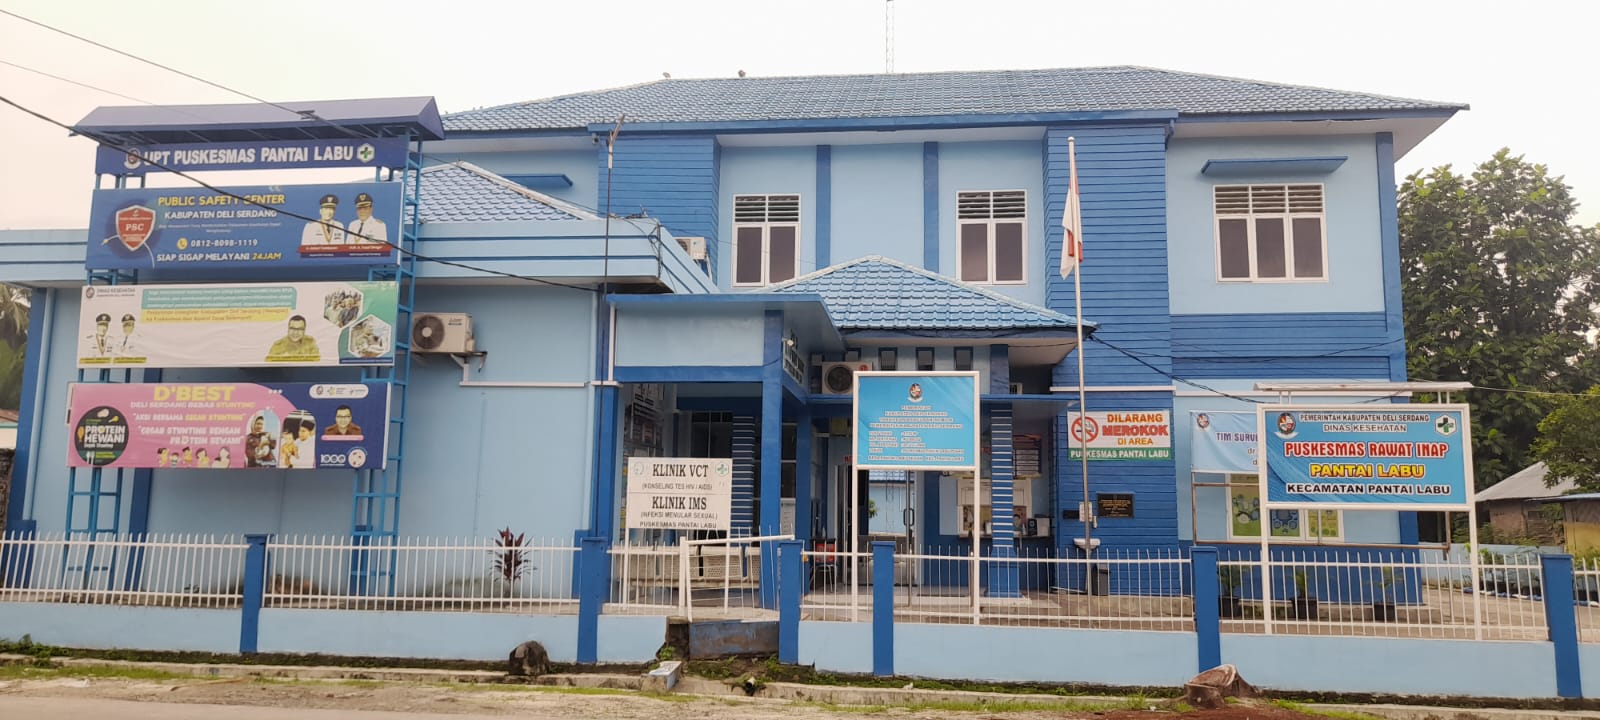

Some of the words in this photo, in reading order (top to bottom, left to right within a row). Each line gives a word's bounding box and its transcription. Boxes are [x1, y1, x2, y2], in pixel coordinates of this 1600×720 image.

[144, 151, 170, 166] UPT
[174, 149, 256, 165] PUSKESMAS
[260, 147, 308, 163] PANTAI
[313, 146, 354, 161] LABU
[158, 197, 195, 206] PUBLIC
[200, 195, 240, 206] SAFETY
[243, 195, 285, 205] CENTER
[164, 210, 214, 219] KABUPATEN
[191, 239, 258, 247] 0812-8098-1119
[205, 253, 250, 261] MELAYANI
[153, 386, 236, 401] D'BEST
[1107, 413, 1163, 423] DILARANG
[1300, 414, 1342, 422] PEMERINTAH
[1343, 414, 1381, 422] KABUPATEN
[85, 425, 126, 433] PROTEIN
[1102, 425, 1169, 437] MEROKOK
[1323, 424, 1351, 433] DINAS
[1353, 424, 1408, 433] KESEHATAN
[84, 433, 125, 443] HEWANI
[1216, 432, 1232, 441] TIM
[1117, 438, 1127, 446] DI
[1128, 438, 1154, 446] AREA
[1070, 450, 1117, 458] PUKESMAS
[1118, 450, 1147, 458] PANTAI
[1247, 447, 1256, 455] dr
[1285, 442, 1366, 458] PUSKESMAS
[1368, 442, 1413, 458] RAWAT
[1415, 443, 1449, 458] INAP
[652, 463, 686, 477] KLINIK
[689, 464, 709, 477] VCT
[1309, 463, 1373, 478] PANTAI
[1377, 465, 1426, 478] LABU
[1286, 484, 1364, 494] KECAMATAN
[1367, 485, 1413, 494] PANTAI
[1416, 485, 1451, 495] LABU
[651, 496, 686, 510] KLINIK
[688, 497, 707, 510] IMS
